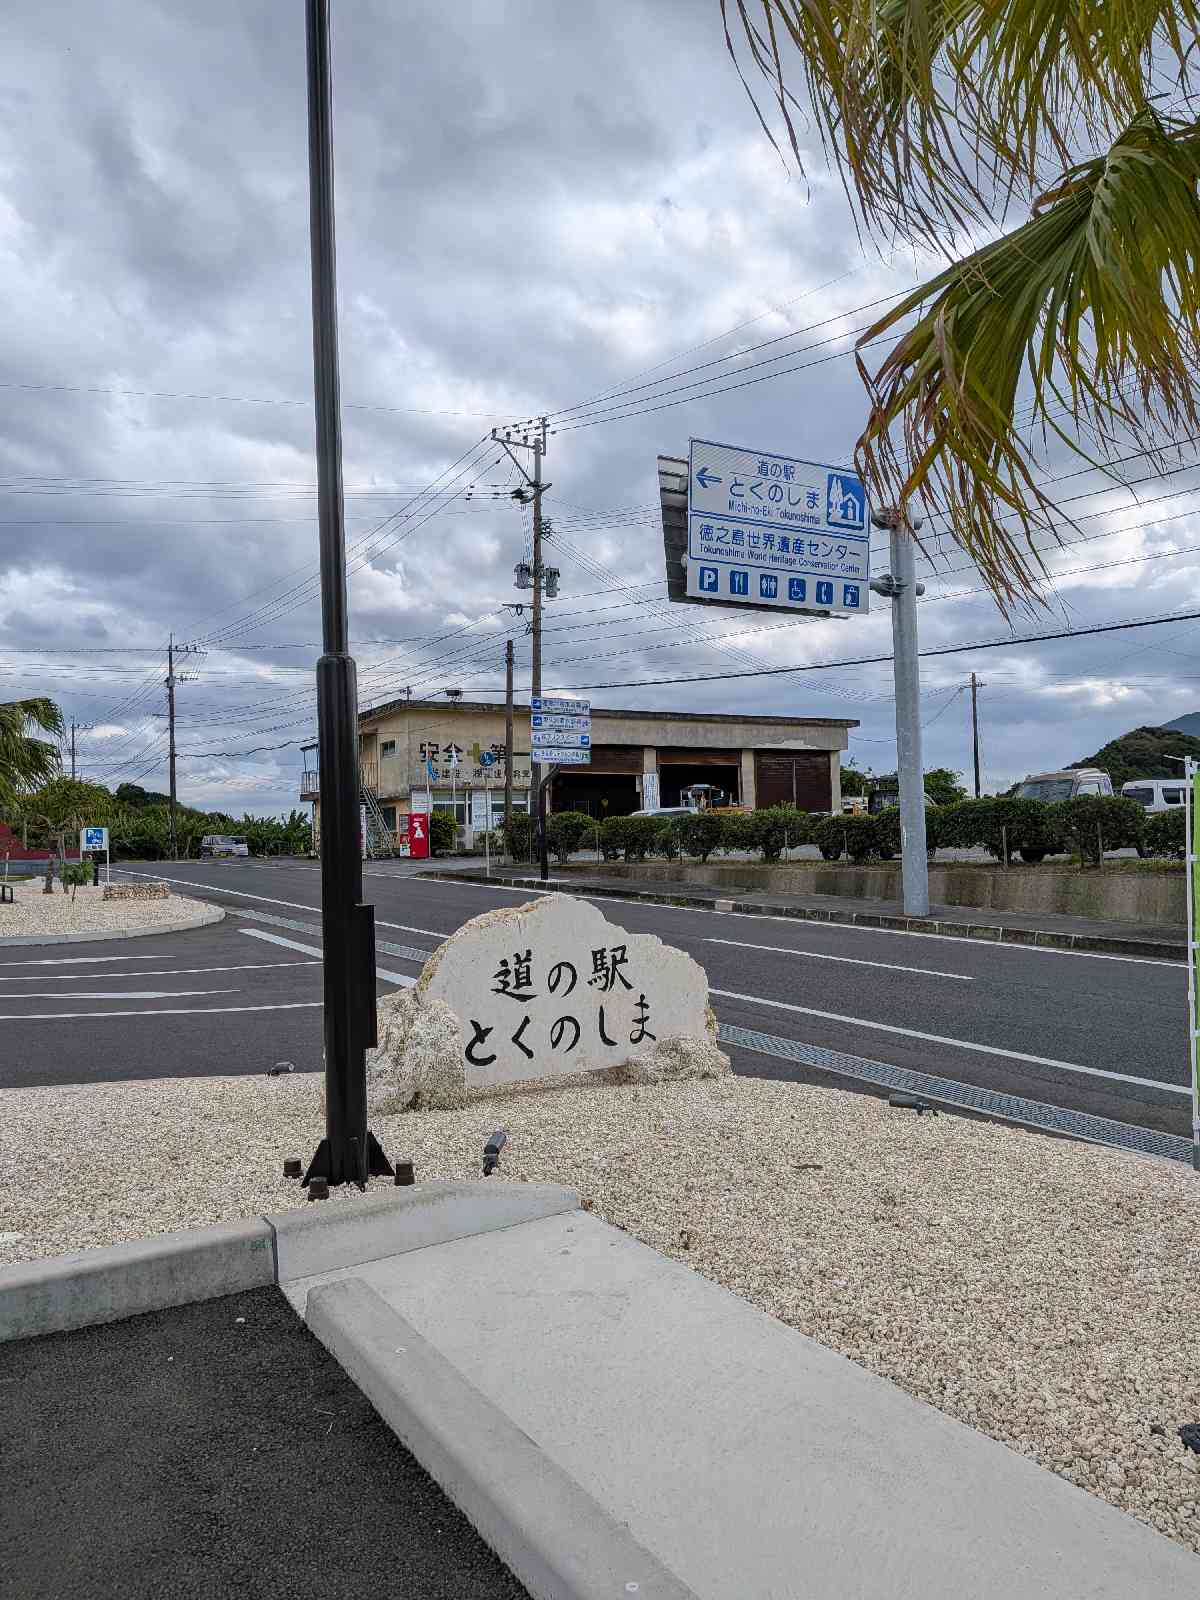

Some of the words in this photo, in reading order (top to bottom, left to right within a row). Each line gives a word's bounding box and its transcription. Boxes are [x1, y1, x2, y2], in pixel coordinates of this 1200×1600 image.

[757, 459, 796, 481] 道の駅
[729, 477, 820, 509] とくのしま
[699, 523, 861, 560] 徳之島世界遺産センター
[703, 569, 716, 589] P
[490, 944, 635, 1003] 道の駅
[464, 993, 657, 1067] とくのしま
